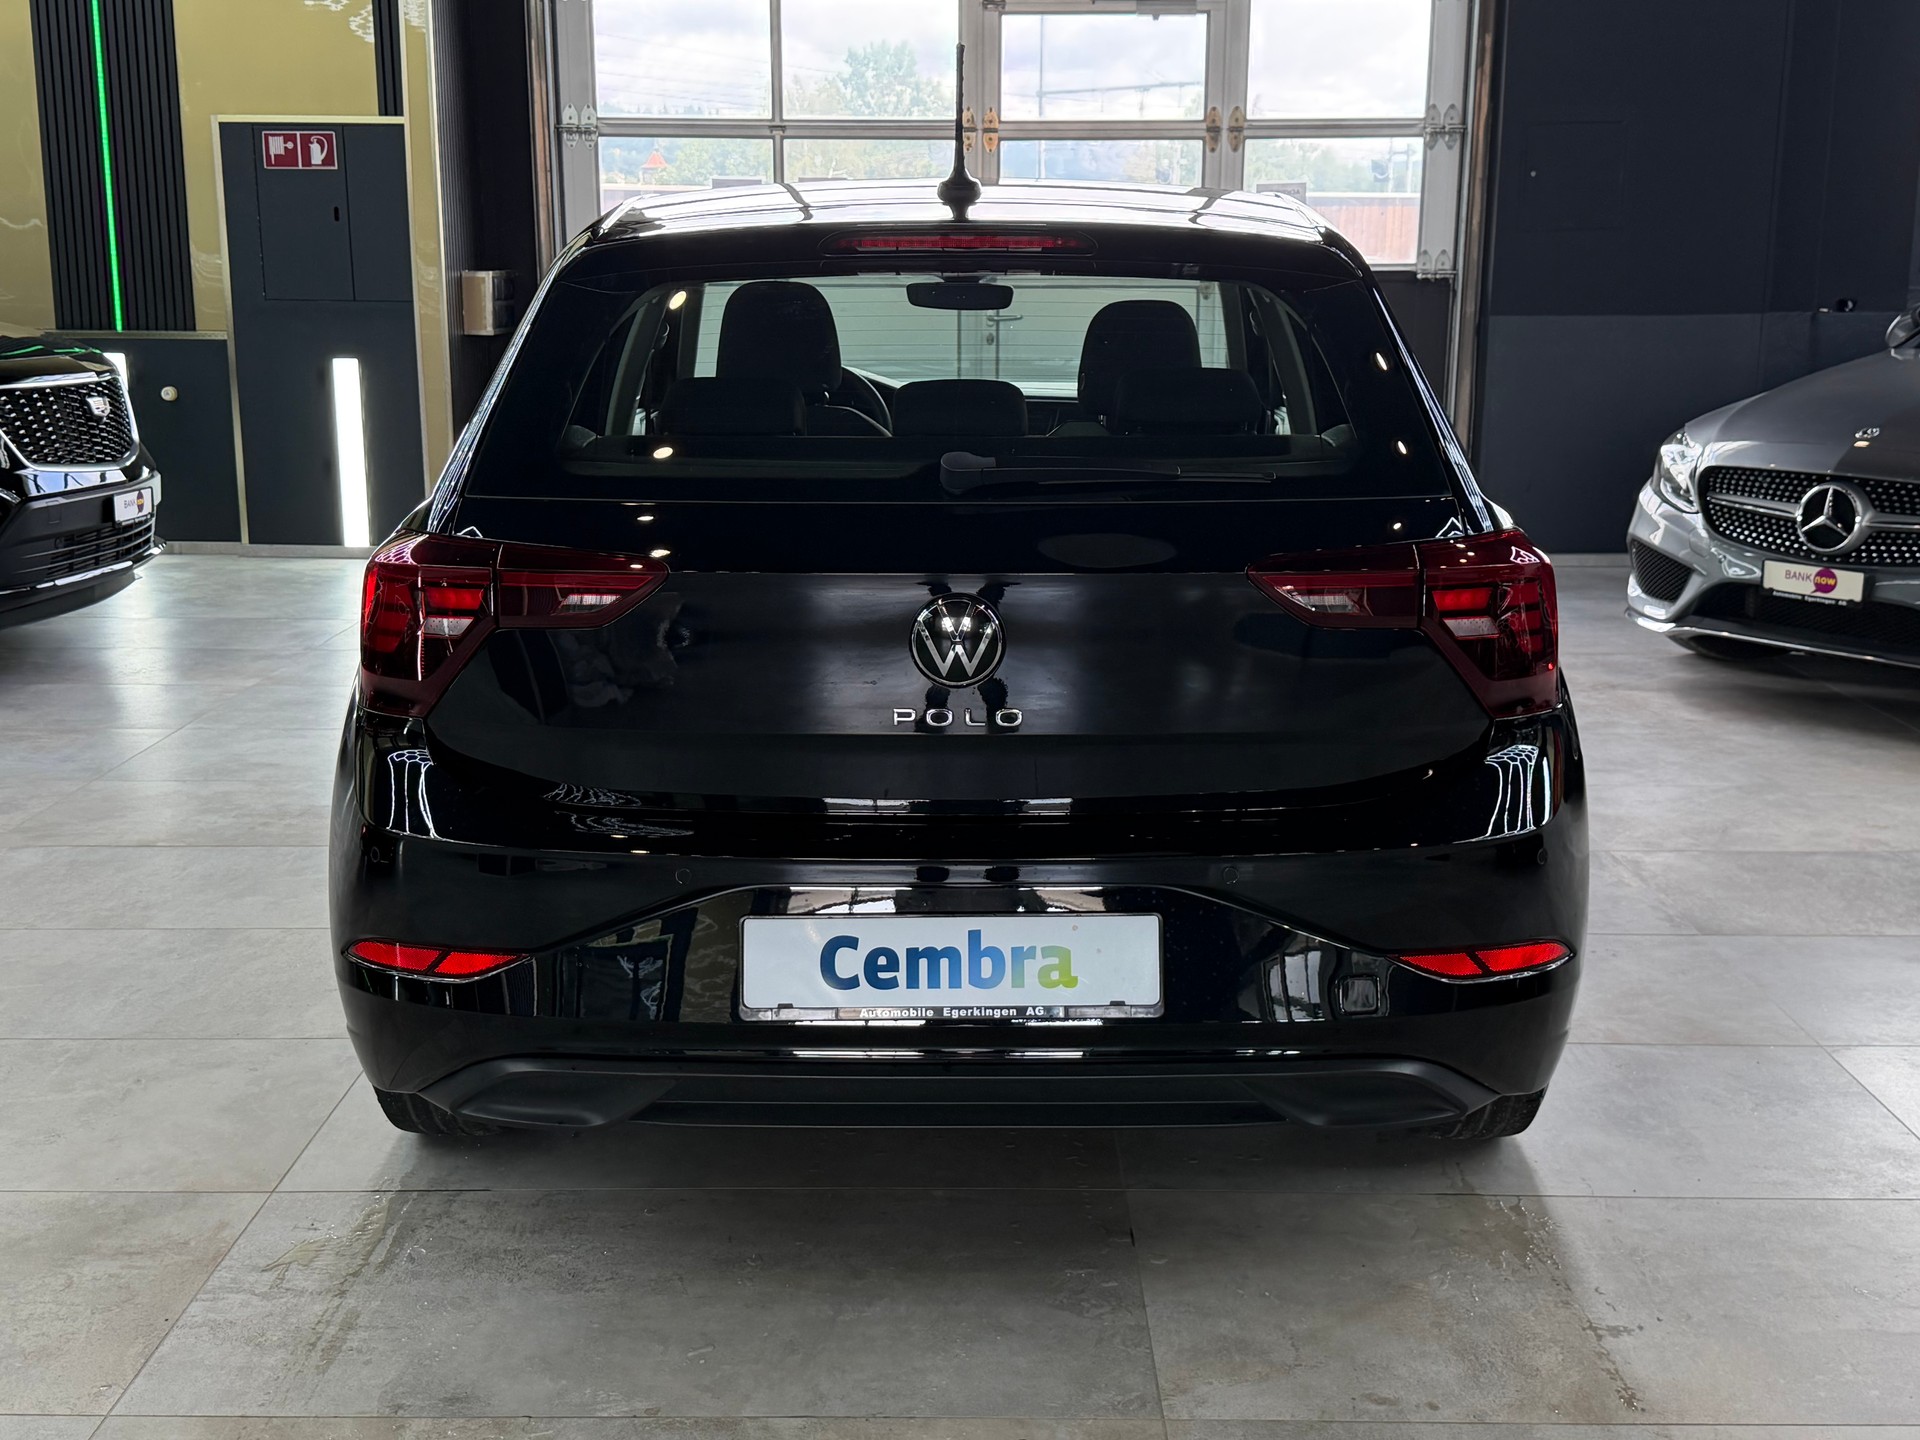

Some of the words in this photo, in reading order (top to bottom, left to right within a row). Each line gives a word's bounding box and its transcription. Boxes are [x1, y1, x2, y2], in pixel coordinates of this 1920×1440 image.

[1784, 569, 1813, 583] BANK
[1814, 576, 1836, 586] now
[893, 708, 1023, 727] POLO
[820, 929, 1079, 991] Cembra
[860, 1007, 934, 1017] Automobile
[943, 1007, 1017, 1017] Egerkingen
[1026, 1007, 1044, 1016] AG
